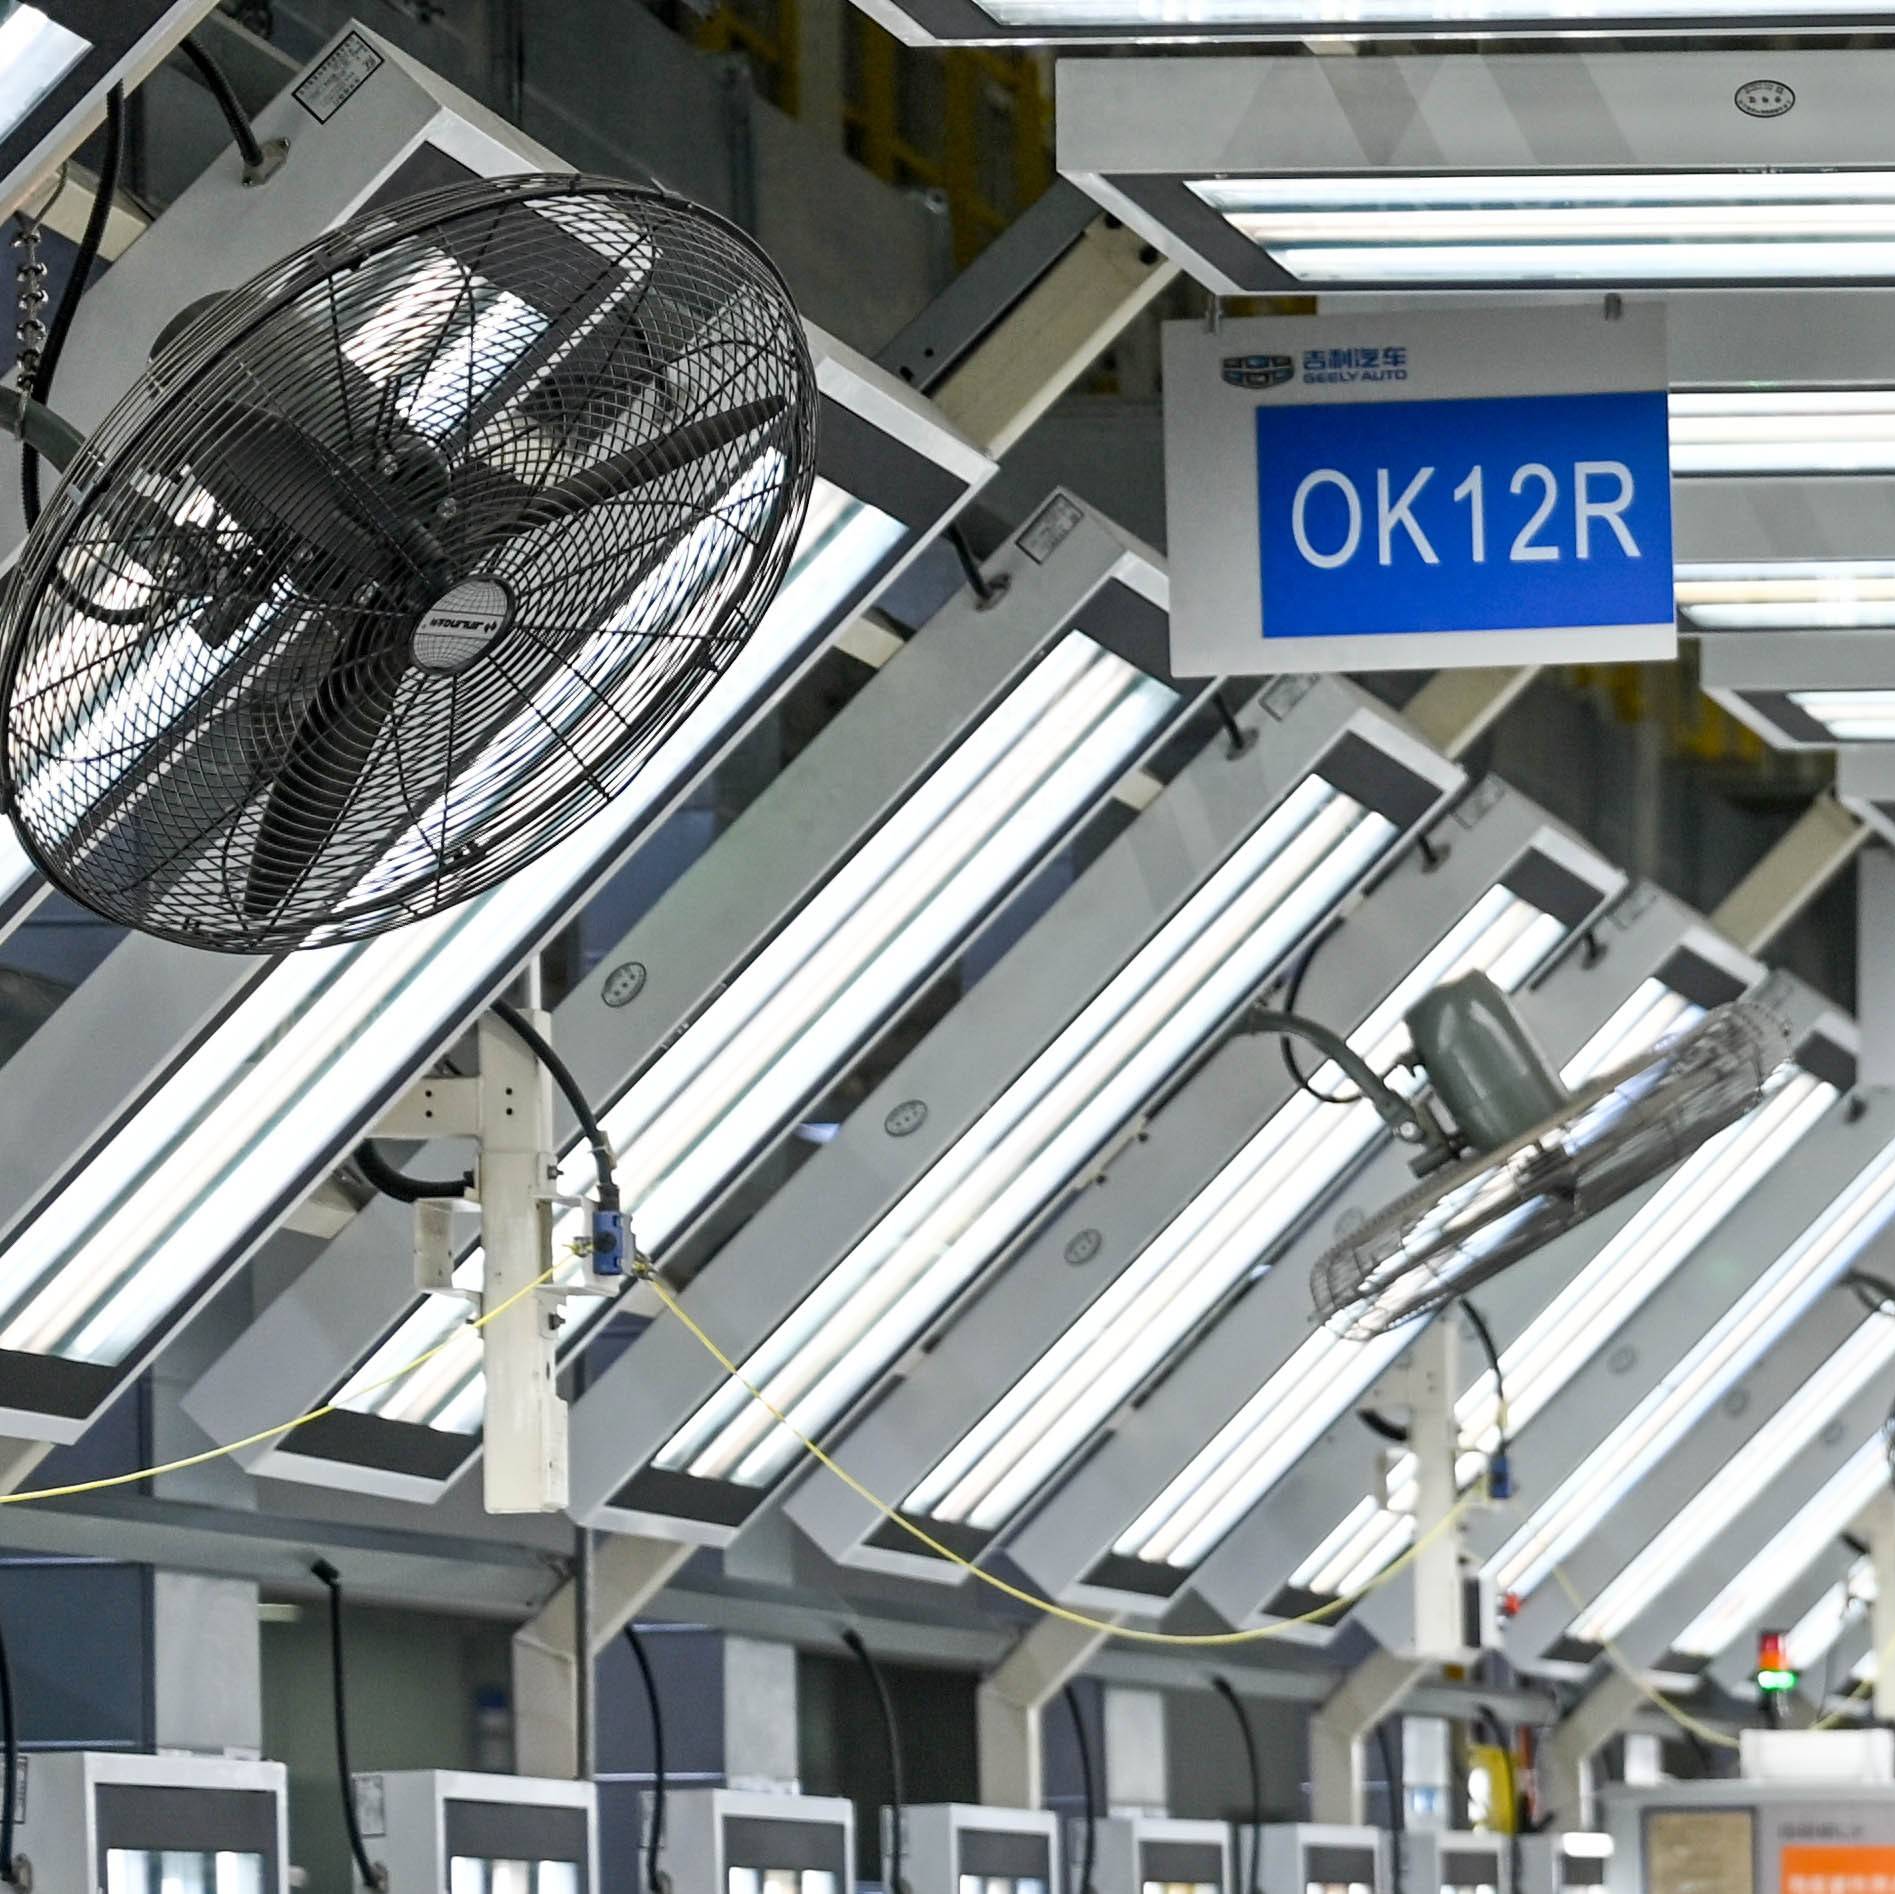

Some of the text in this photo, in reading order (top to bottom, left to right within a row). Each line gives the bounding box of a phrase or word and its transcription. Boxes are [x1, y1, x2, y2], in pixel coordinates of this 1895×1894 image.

[1303, 347, 1407, 370] 吉利汽车
[1303, 370, 1408, 384] GEELY AUTO
[1291, 460, 1642, 569] OK12R
